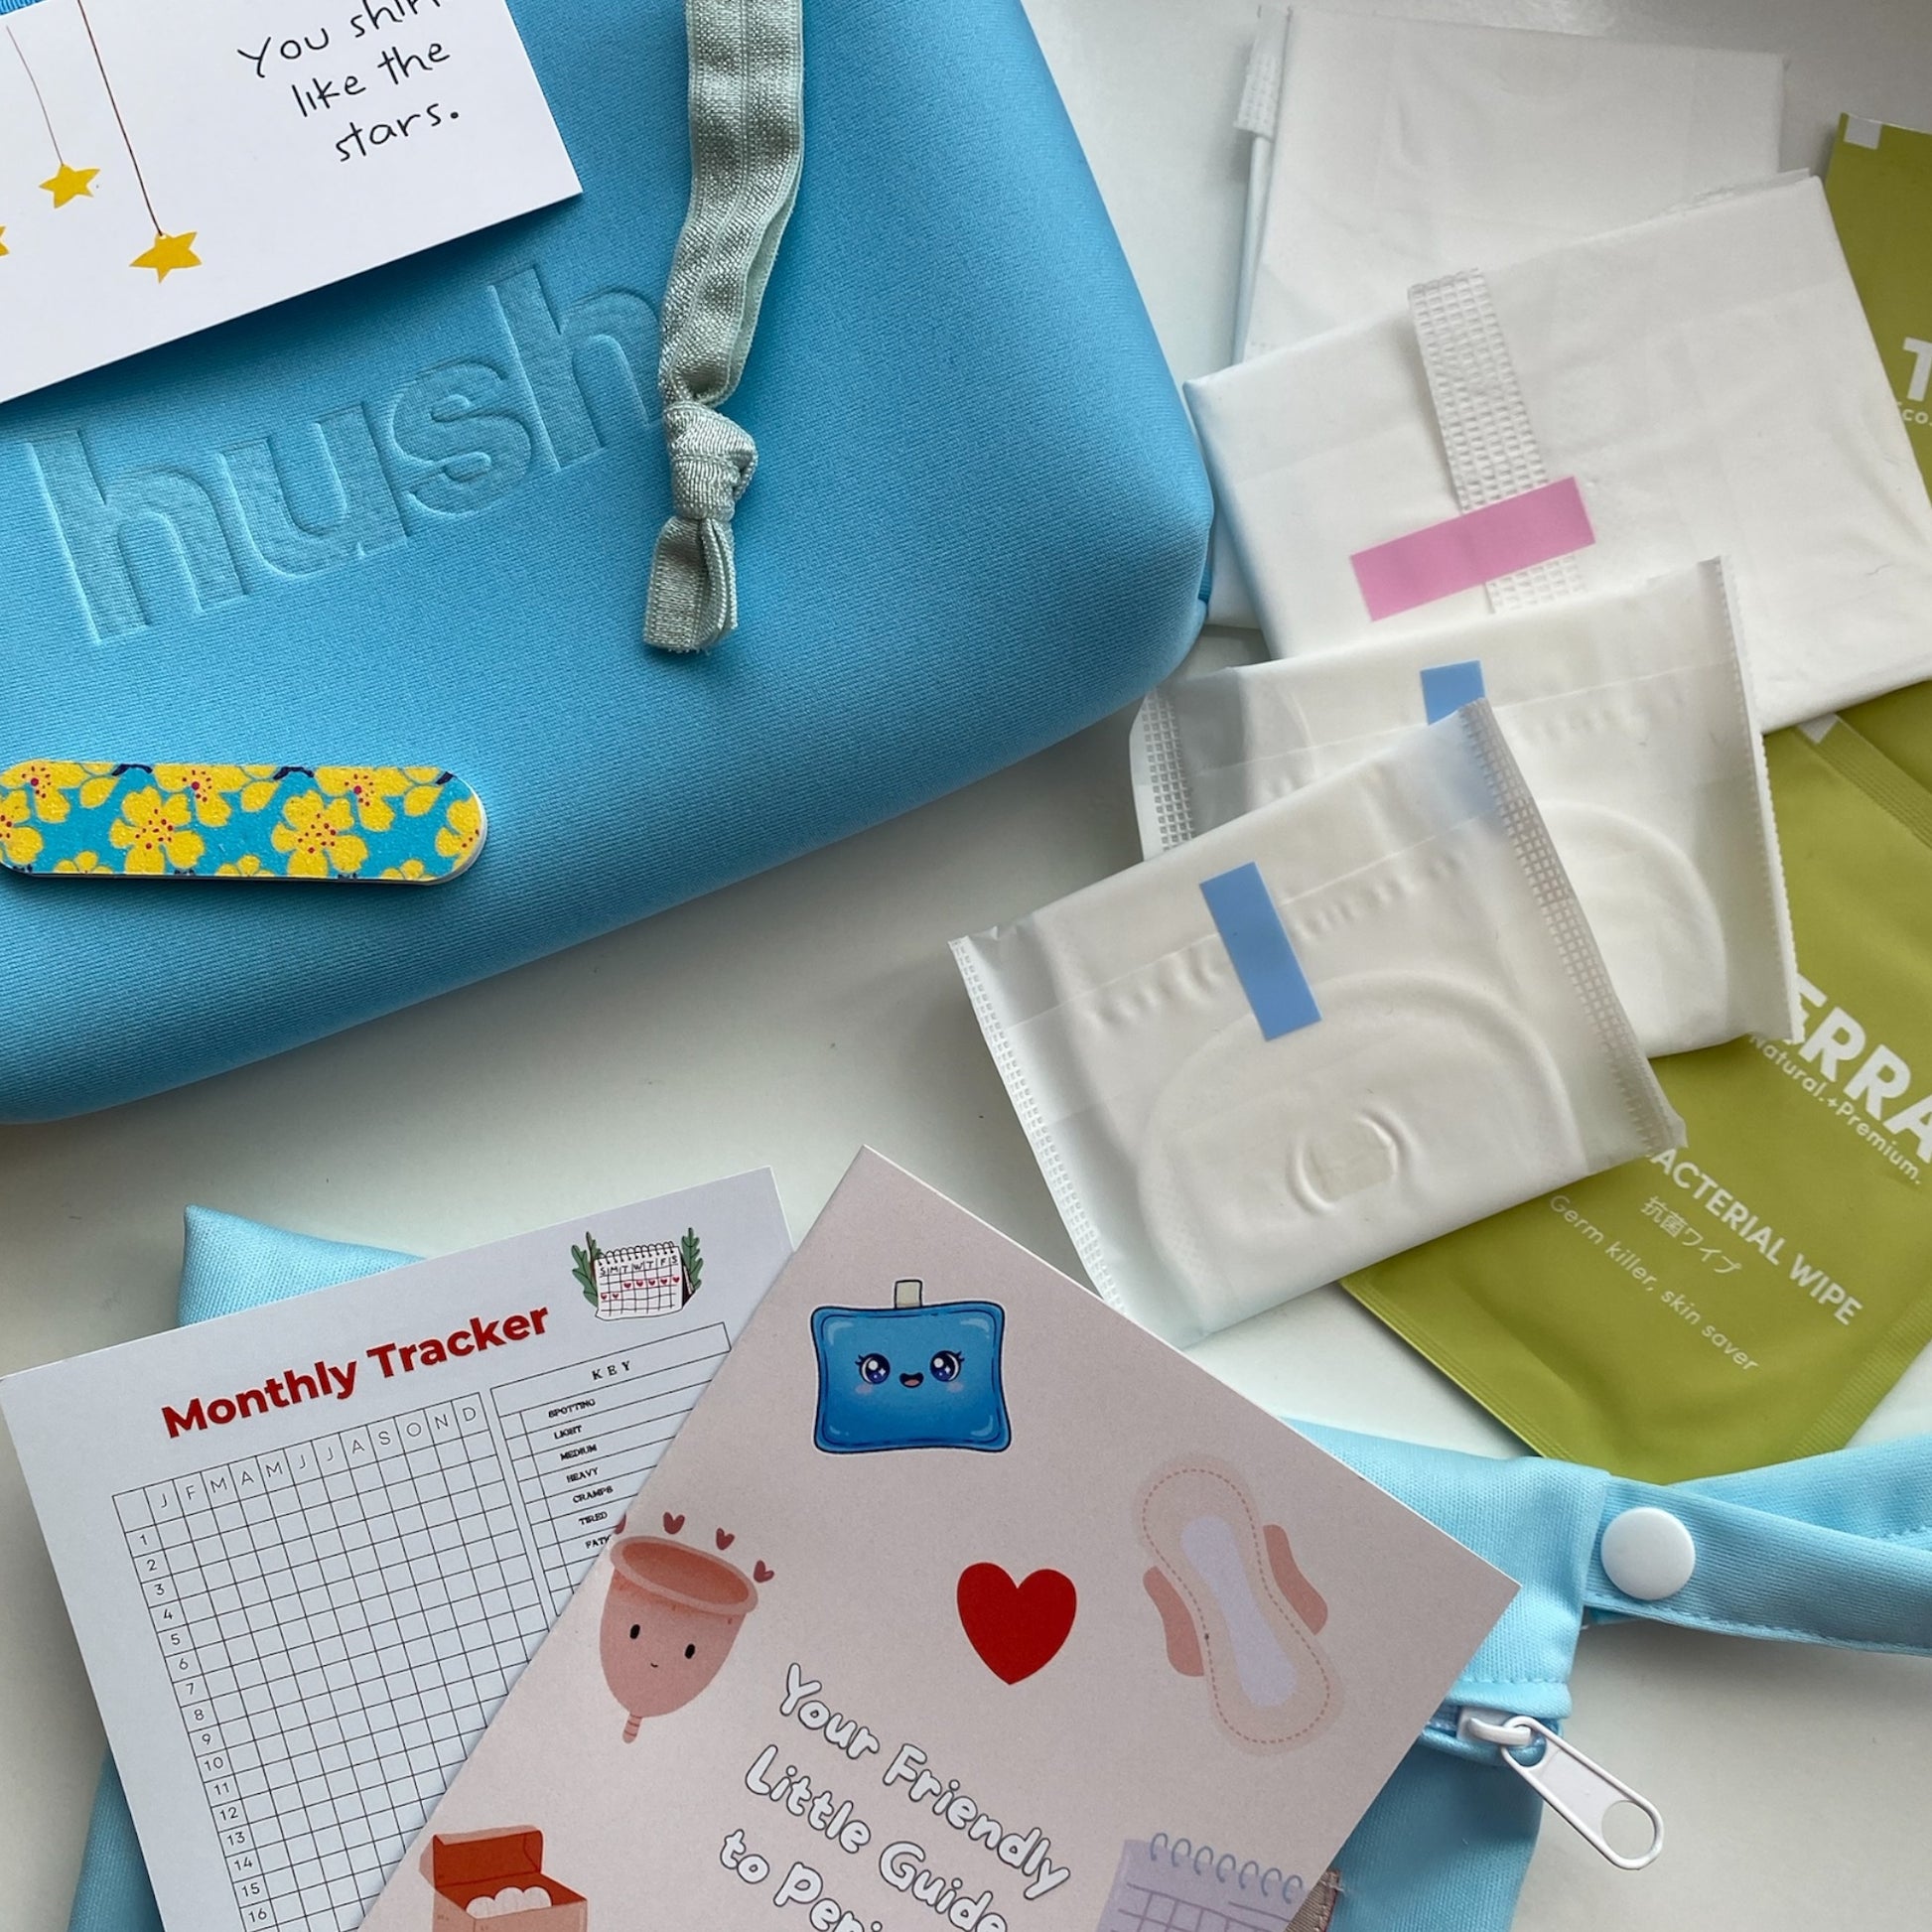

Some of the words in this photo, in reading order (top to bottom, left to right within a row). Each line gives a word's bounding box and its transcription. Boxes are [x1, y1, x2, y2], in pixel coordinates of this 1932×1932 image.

[237, 28, 330, 78] You
[291, 75, 366, 117] like
[377, 43, 450, 84] the
[336, 103, 460, 162] stars.
[23, 264, 663, 645] hush
[1640, 1195, 1742, 1274] 抗菌ワイプ
[1645, 1148, 1787, 1266] ACTERIAL
[1789, 1253, 1863, 1326] WIPE
[1550, 1194, 1605, 1245] Germ
[1604, 1242, 1658, 1292] killer,
[1661, 1288, 1702, 1326] skin
[1702, 1323, 1758, 1371] saver
[161, 1361, 357, 1439] Monthly
[366, 1307, 549, 1378] Tracker
[548, 1398, 596, 1419] SPOTTING
[553, 1425, 582, 1440] LIGHT
[161, 1493, 168, 1508] J
[186, 1485, 196, 1500] F
[210, 1477, 227, 1494] M
[241, 1470, 254, 1485] A
[266, 1461, 283, 1478] M
[298, 1454, 306, 1469] J
[327, 1447, 335, 1461] J
[351, 1440, 365, 1454] A
[379, 1431, 391, 1446] S
[406, 1422, 423, 1438] O
[435, 1414, 449, 1431] N
[463, 1407, 477, 1423] D
[560, 1444, 598, 1461] MEDIUM
[566, 1467, 599, 1483] HEAVY
[572, 1485, 614, 1504] CRAMPS
[578, 1511, 609, 1526] TIRED
[139, 1534, 148, 1546] 1
[146, 1559, 157, 1572] 2
[154, 1584, 165, 1595] 3
[163, 1608, 174, 1620] 4
[171, 1633, 181, 1646] 5
[179, 1658, 189, 1670] 6
[186, 1682, 195, 1695] 7
[194, 1709, 205, 1721] 8
[202, 1733, 211, 1745] 9
[204, 1756, 224, 1772] 10
[213, 1782, 230, 1795] 11
[779, 1662, 881, 1759] Your
[883, 1742, 1071, 1900] Friendly
[219, 1806, 239, 1821] 12
[226, 1832, 246, 1846] 13
[745, 1744, 872, 1854] Little
[879, 1841, 1008, 1932] Guide
[233, 1857, 253, 1871] 14
[720, 1829, 770, 1884] to
[241, 1882, 261, 1897] 15
[248, 1908, 268, 1923] 16
